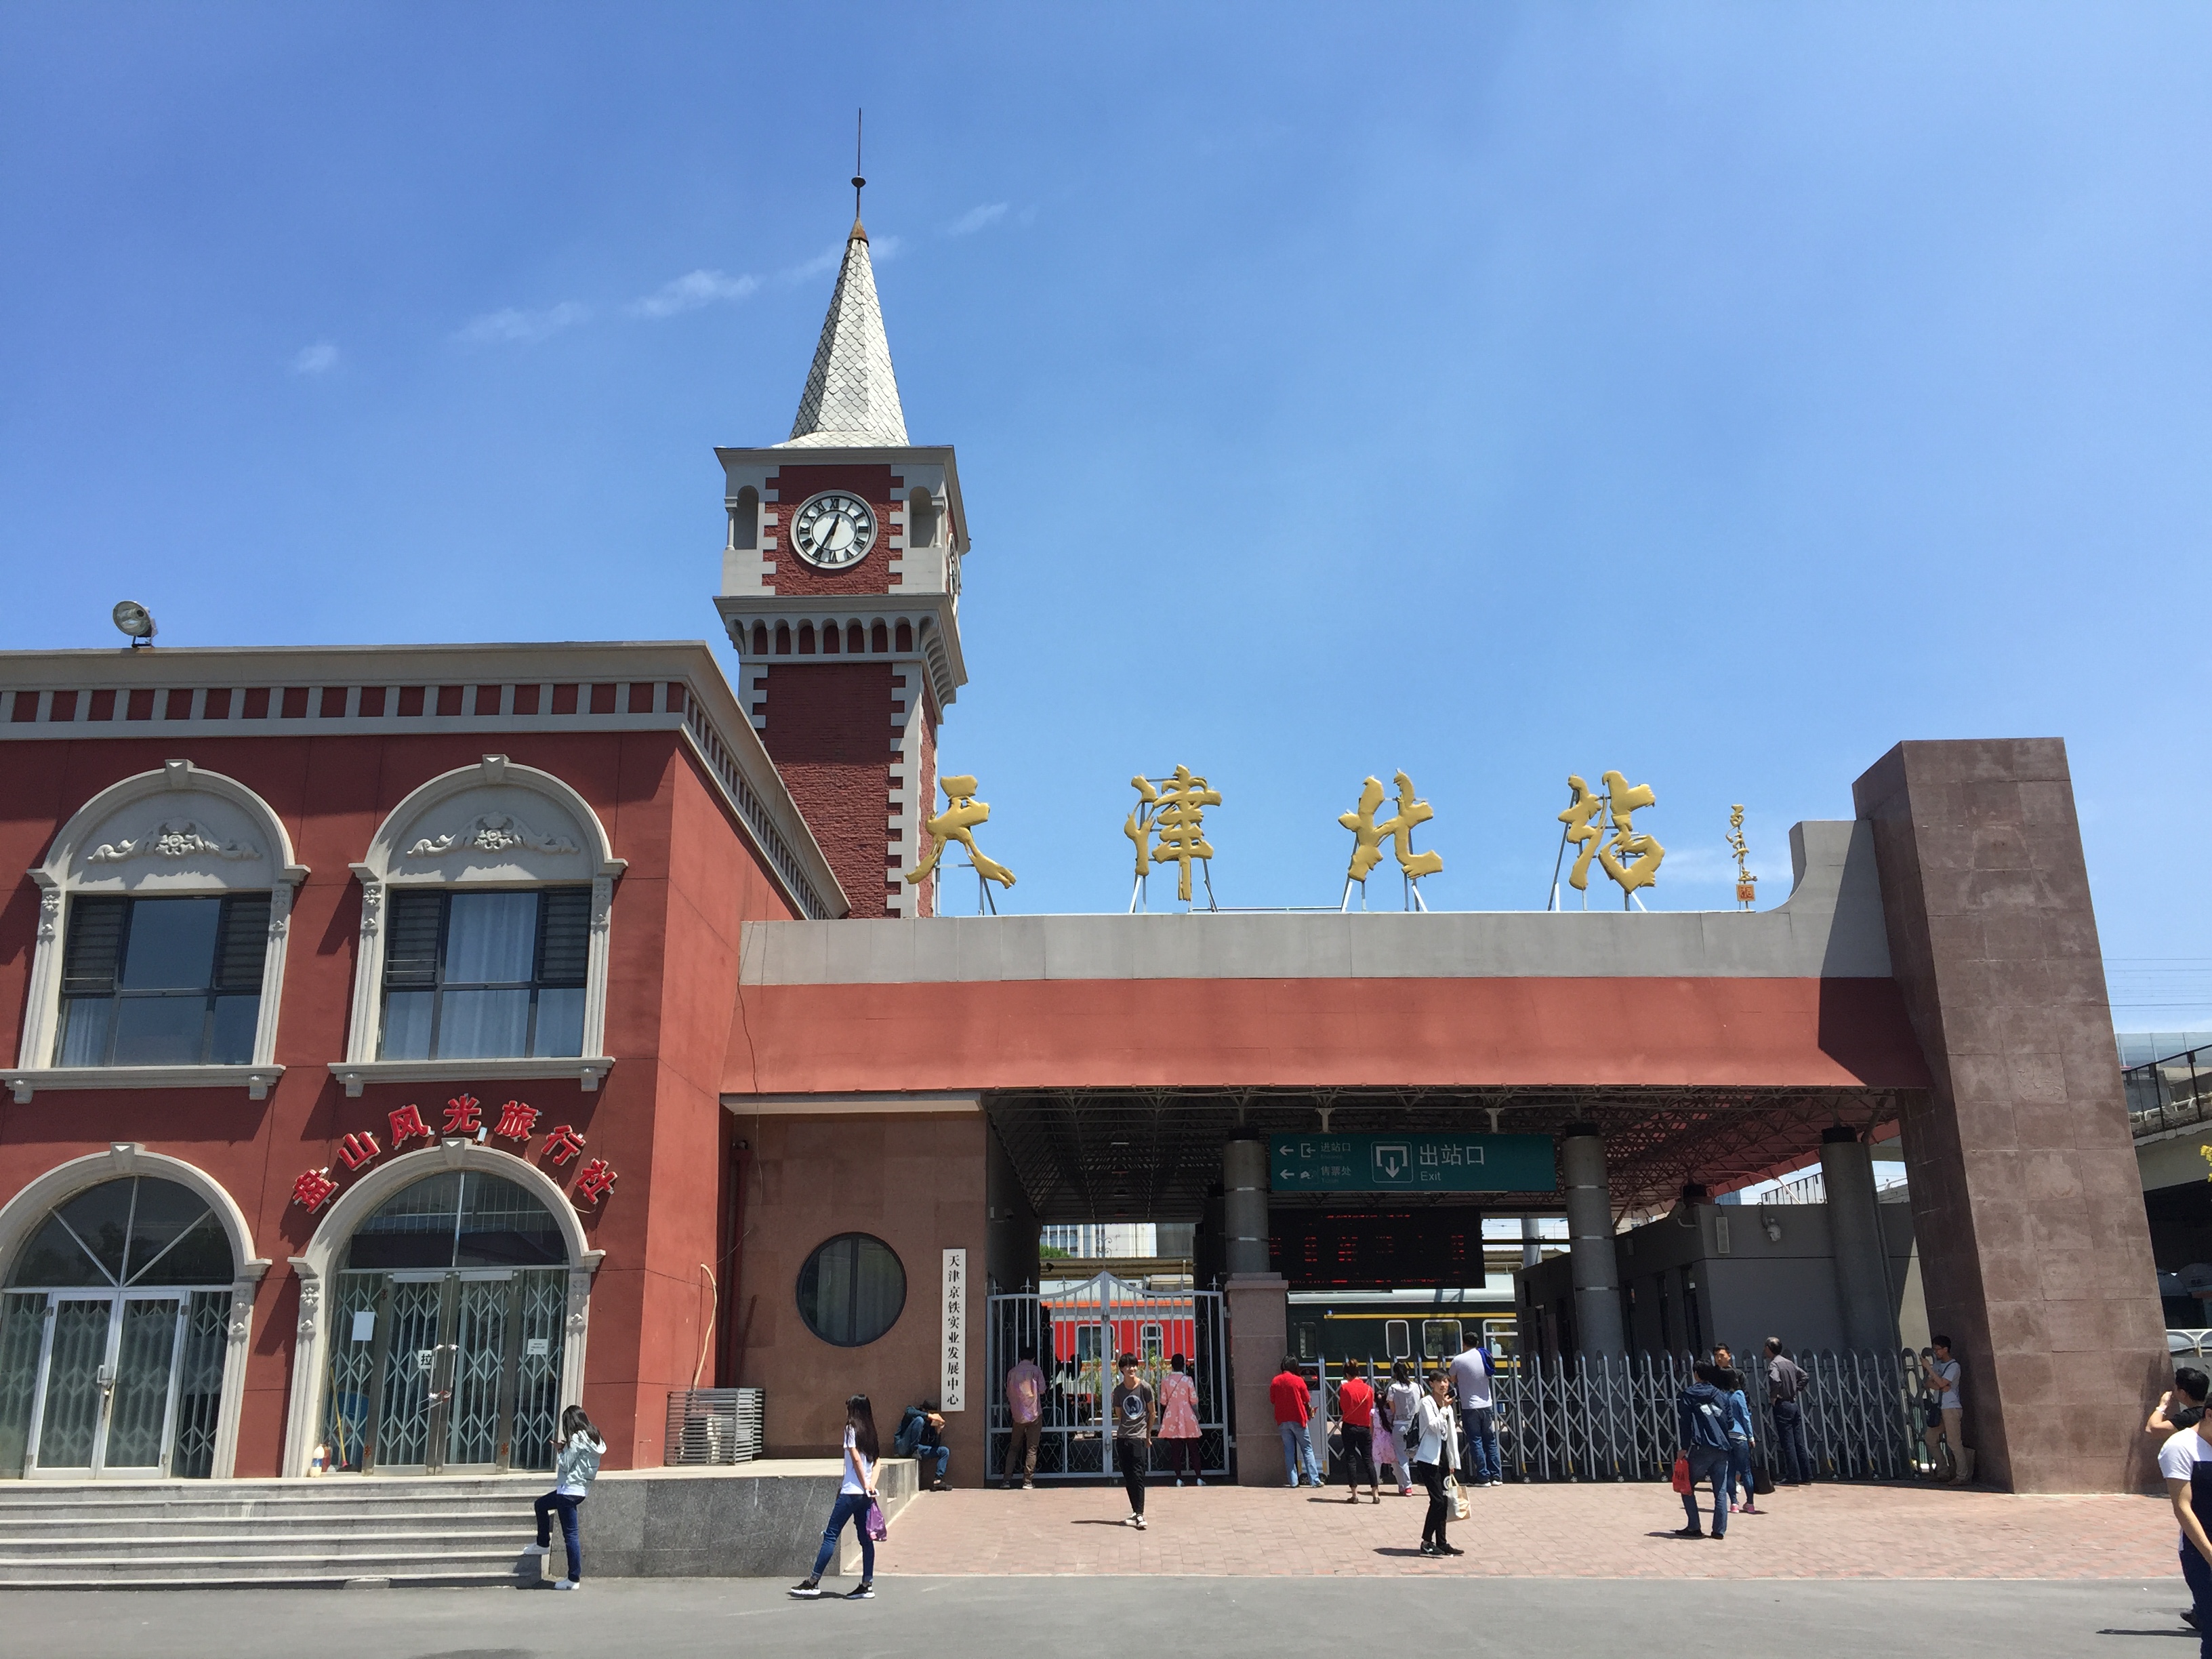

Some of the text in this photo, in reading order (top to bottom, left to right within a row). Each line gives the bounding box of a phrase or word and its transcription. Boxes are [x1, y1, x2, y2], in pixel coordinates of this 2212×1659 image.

[830, 498, 840, 509] XII
[804, 512, 816, 522] X
[1320, 1141, 1351, 1152] 进站口
[292, 1094, 617, 1214] 盘山风光旅行社
[1419, 1143, 1485, 1166] 出站口
[1320, 1166, 1351, 1176] 售票处
[1420, 1171, 1441, 1181] Exit
[947, 1254, 961, 1406] 天津京铁实业发展中心
[420, 1353, 432, 1366] 拉
